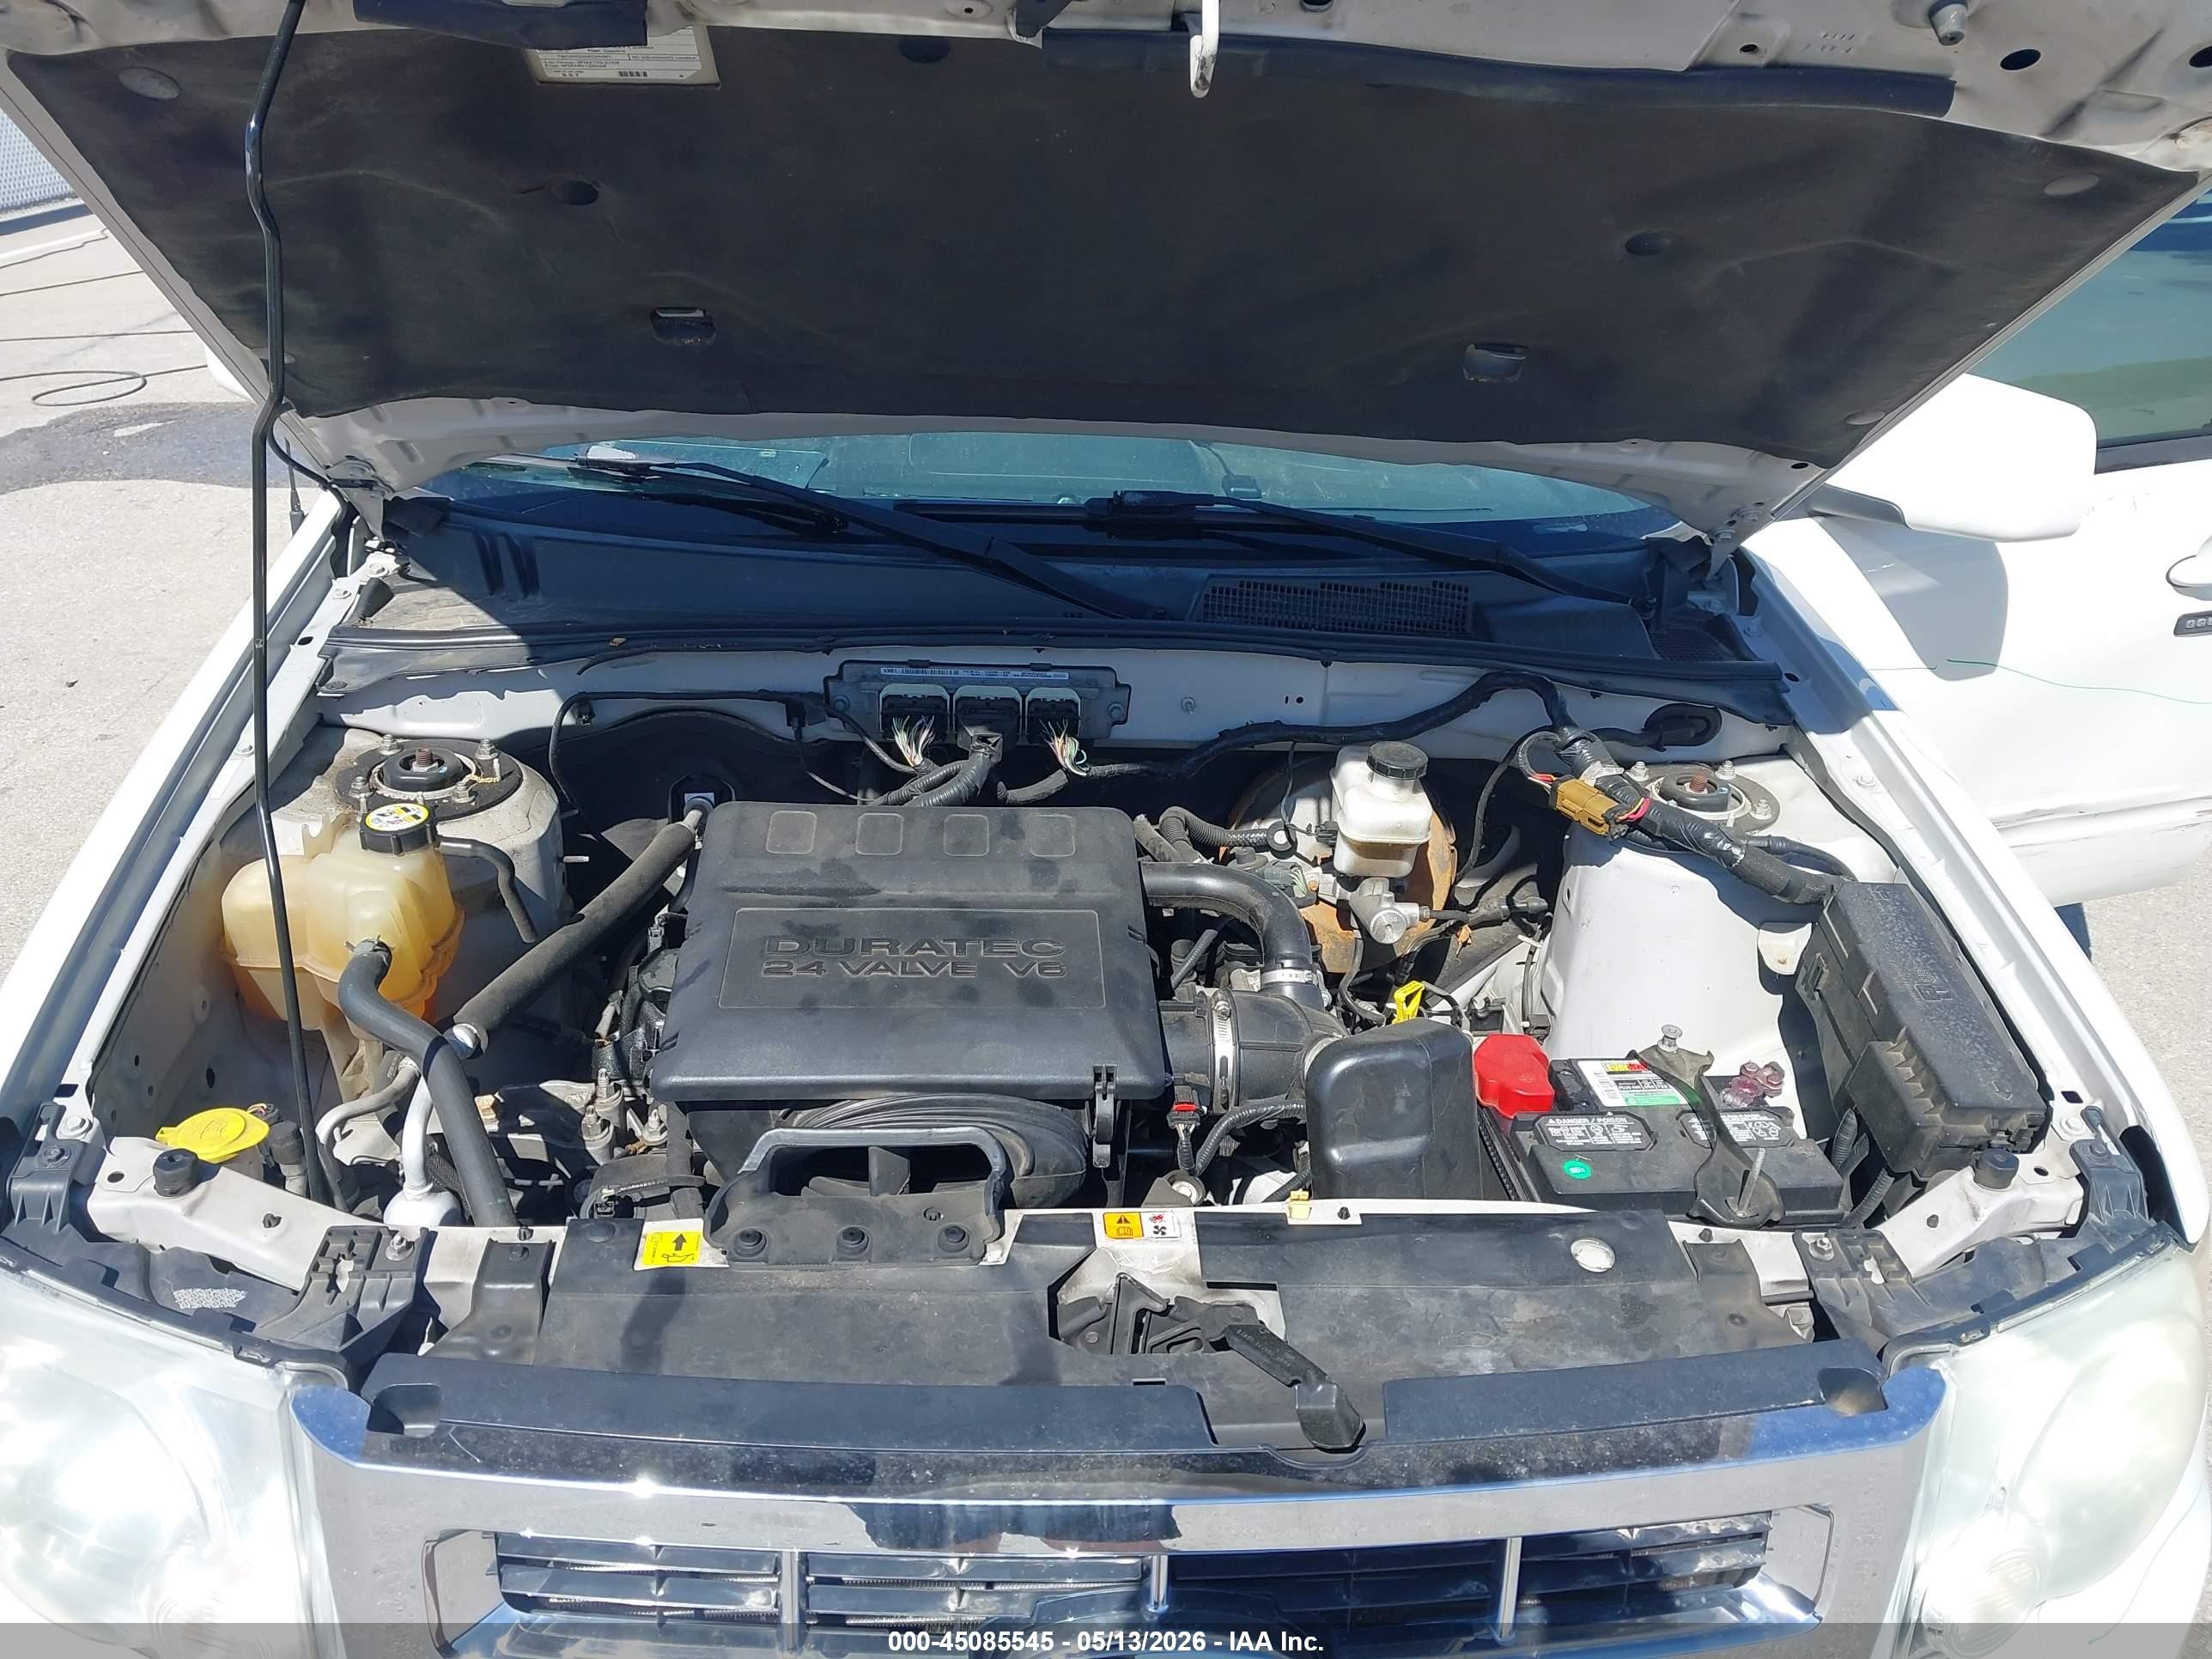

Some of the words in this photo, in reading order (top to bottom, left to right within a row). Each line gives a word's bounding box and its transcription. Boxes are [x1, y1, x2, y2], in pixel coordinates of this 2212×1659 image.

[763, 937, 1066, 958] DURATEC
[763, 960, 827, 977] 24
[839, 961, 976, 977] VALVE
[1003, 961, 1066, 977] V6
